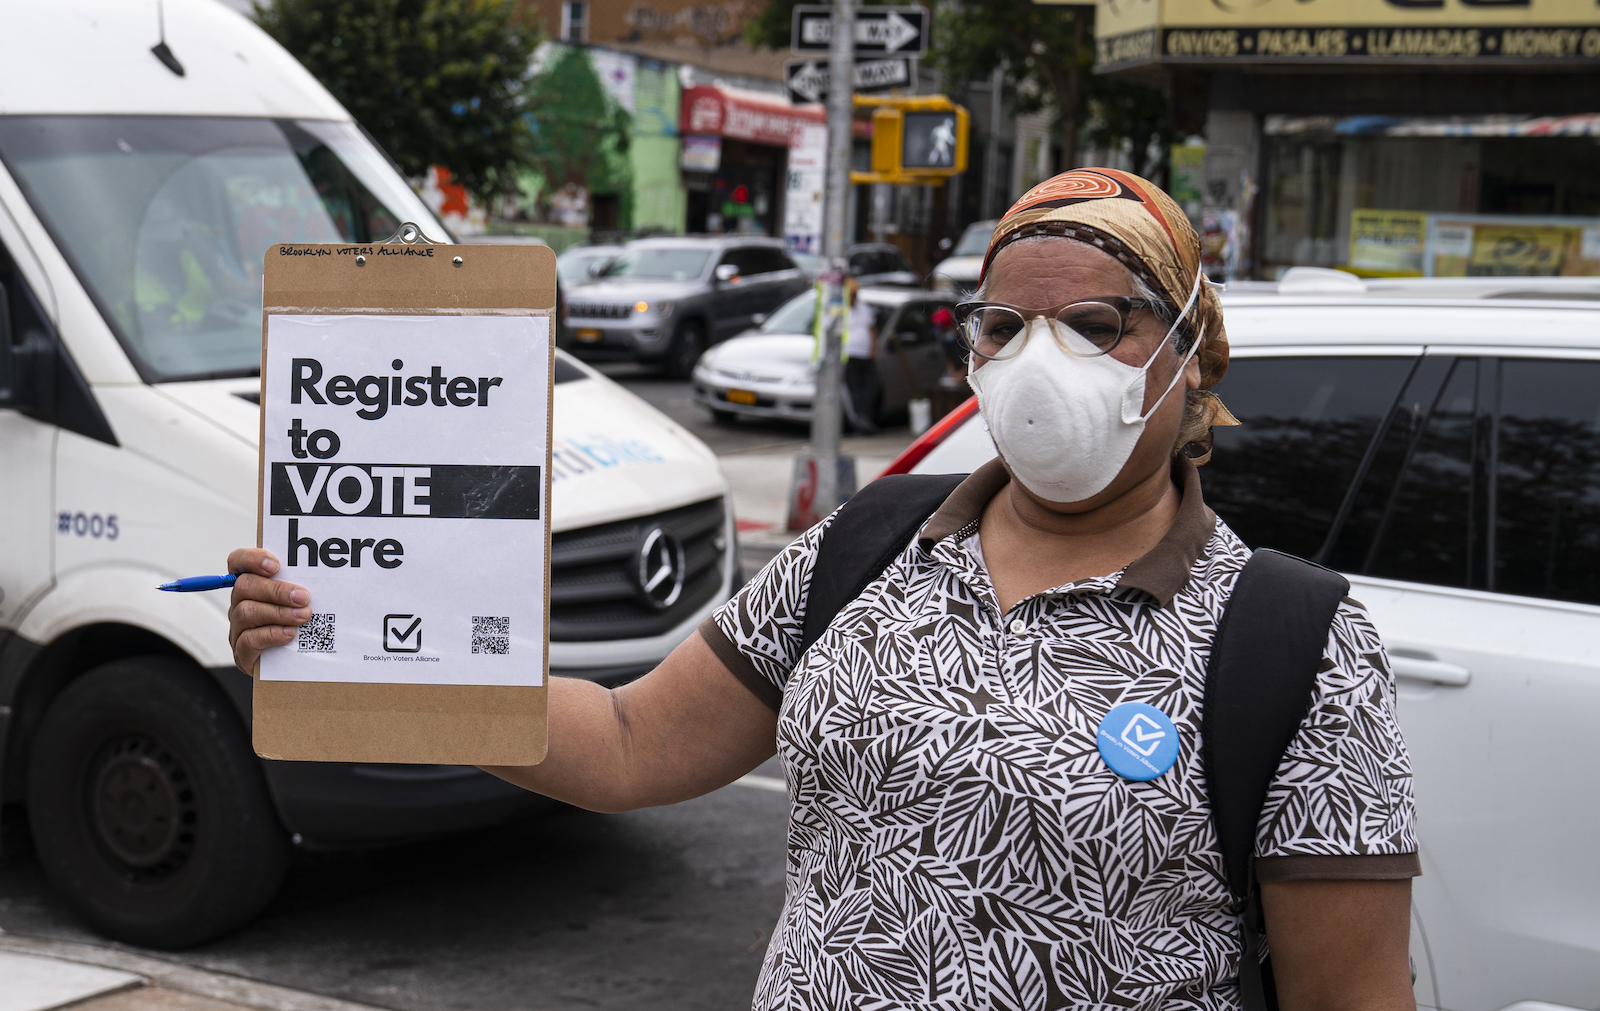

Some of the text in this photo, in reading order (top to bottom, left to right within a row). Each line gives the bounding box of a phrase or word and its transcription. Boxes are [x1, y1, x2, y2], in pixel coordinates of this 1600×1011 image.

[866, 25, 903, 37] WAY
[1167, 30, 1239, 56] ENVIOS
[1256, 30, 1348, 56] PASAJES
[1367, 29, 1482, 57] LLAMADAS
[1501, 29, 1582, 57] MONEY
[859, 64, 897, 82] WAY
[279, 246, 434, 257] BROOKLYN VOTERS ALLIANCE
[290, 358, 503, 421] Register
[287, 418, 341, 459] to
[284, 464, 431, 516] VOTE
[58, 511, 119, 541] #005
[287, 518, 404, 569] here
[363, 654, 391, 662] Brooklyn
[414, 655, 440, 663] Alliance
[1100, 729, 1160, 774] Brooklyn Voters Alliance
